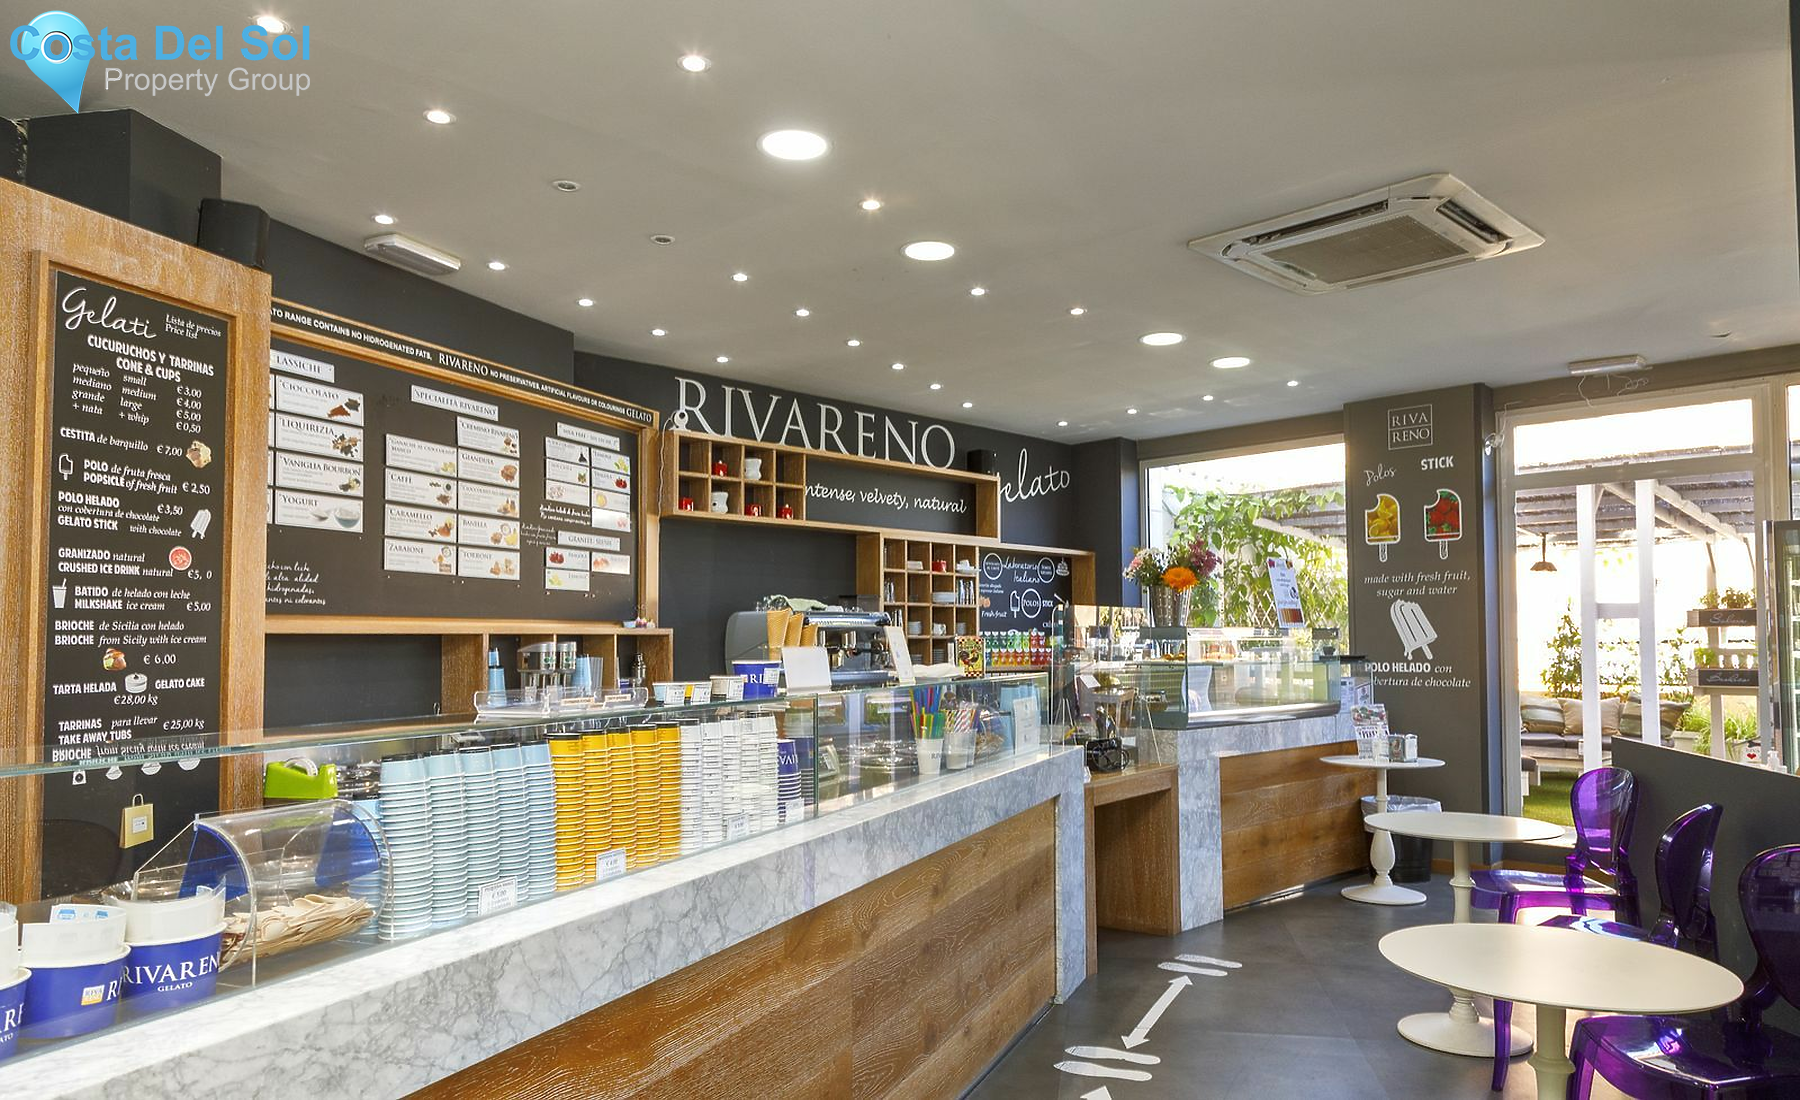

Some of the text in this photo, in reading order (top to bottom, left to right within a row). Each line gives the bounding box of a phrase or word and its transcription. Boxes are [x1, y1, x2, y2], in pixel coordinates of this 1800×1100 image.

[62, 286, 157, 339] Gelati
[165, 324, 198, 339] Price list
[166, 314, 222, 337] Lista de precios
[87, 334, 214, 377] CUCURUCHOS Y TARRINAS
[73, 363, 147, 386] pequeño small
[116, 357, 181, 383] CONE & CUPS
[284, 311, 313, 327] RANGE
[313, 319, 350, 337] CONTAINS
[351, 330, 362, 340] NO
[438, 352, 489, 377] RIVARENO
[490, 370, 499, 380] NO
[626, 407, 652, 423] GELATO
[73, 376, 157, 401] mediano medium
[72, 389, 105, 403] grande
[120, 397, 142, 411] large
[82, 404, 103, 415] nata
[127, 412, 150, 427] whip
[670, 376, 957, 469] RIVARENO
[1391, 412, 1428, 428] RIVA
[60, 427, 96, 442] CESTITA
[96, 434, 109, 445] de
[109, 435, 149, 451] barquillo
[1392, 428, 1430, 443] RENO
[83, 459, 171, 482] POLO de fruta fresca
[281, 456, 361, 477] VANIGLIA BOURBON
[1421, 456, 1454, 470] STICK
[83, 472, 125, 488] POPSICLE
[125, 477, 136, 490] of
[134, 479, 157, 492] fresh
[156, 482, 178, 495] fruit
[999, 447, 1071, 503] elato
[1364, 463, 1397, 487] Polos
[58, 491, 120, 509] POLO HELADO
[281, 494, 318, 507] YOGURT
[803, 482, 967, 514] ntense, velvety, natural
[57, 505, 74, 513] con
[74, 506, 114, 518] cobertura
[114, 508, 125, 518] de
[125, 510, 160, 523] chocolate
[57, 515, 182, 537] GELATO STICK with chocolate
[58, 548, 145, 563] GRANIZADO natural
[58, 562, 173, 578] CRUSHED ICE DRINK natural
[1364, 574, 1389, 584] made
[1391, 572, 1414, 583] with
[1415, 571, 1441, 585] fresh
[74, 586, 191, 600] BATIDO de helado con leche
[1376, 585, 1458, 599] sugar and water
[74, 599, 165, 611] MILKSHAKE ice cream
[54, 620, 185, 632] BRIOCHE de Sicilia con helado
[54, 634, 207, 648] BRIOCHE from Sicily with ice cream
[1365, 662, 1452, 673] POLO HELADO con
[52, 677, 206, 695] TARTA HELADA GELATO CAKE
[1373, 676, 1471, 687] bertura de chocolate
[147, 694, 158, 705] kg
[58, 716, 205, 732] TARRINAS para llevar kg
[58, 730, 132, 746] TAKE AWAY TUBS
[157, 981, 193, 993] GELATO
